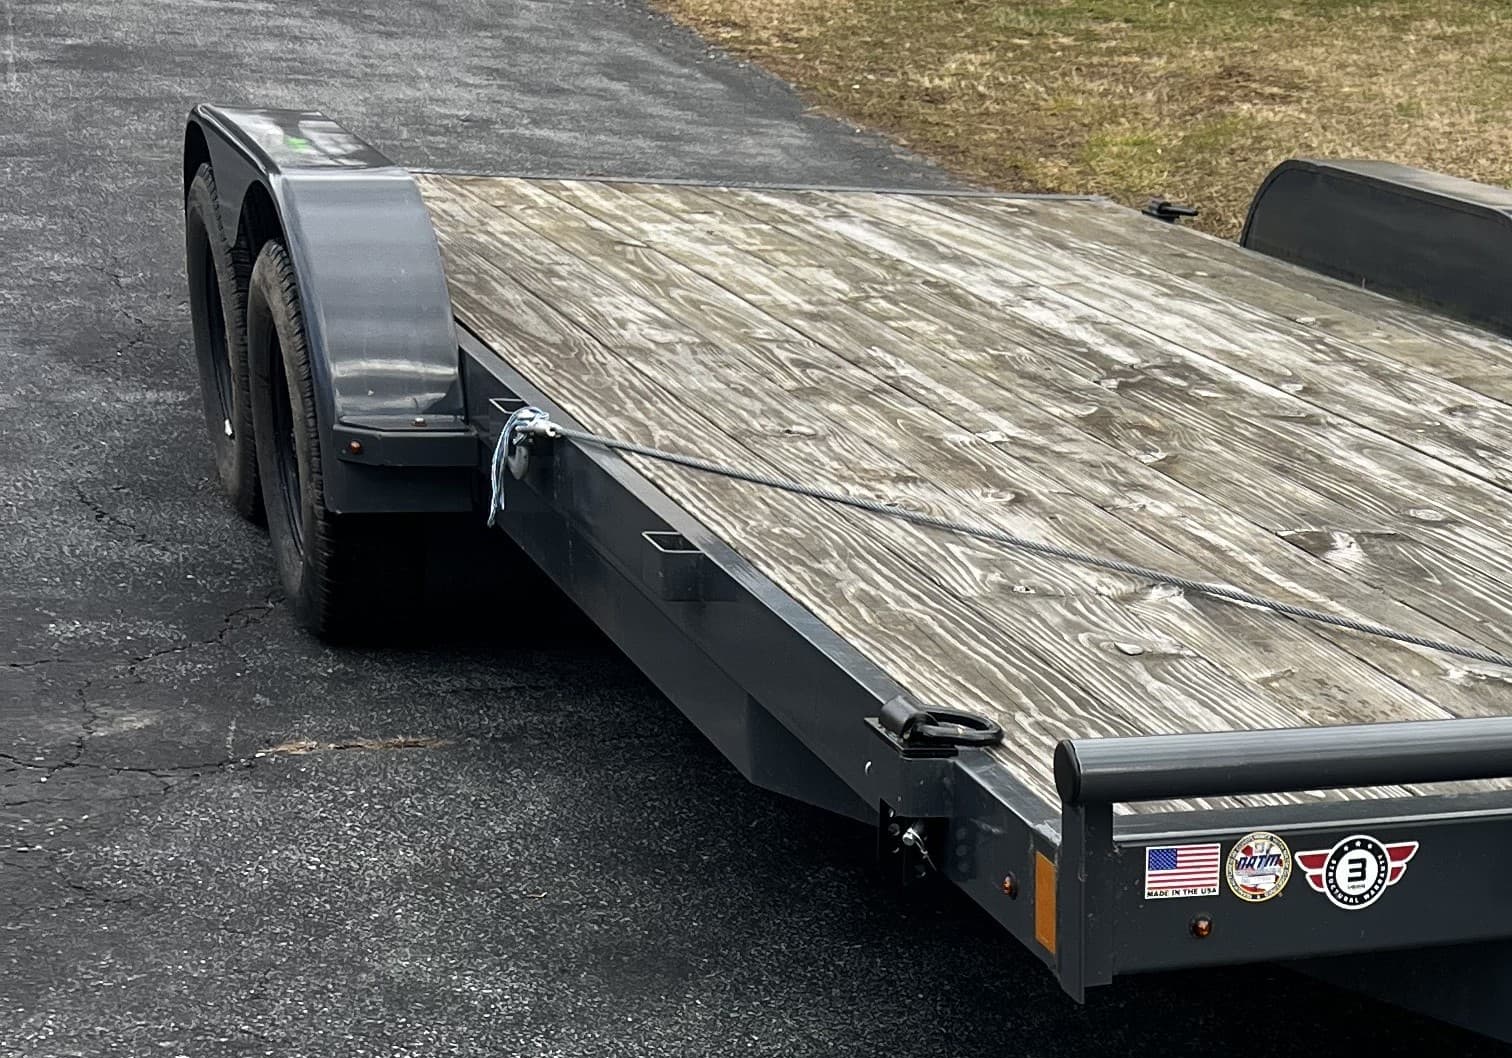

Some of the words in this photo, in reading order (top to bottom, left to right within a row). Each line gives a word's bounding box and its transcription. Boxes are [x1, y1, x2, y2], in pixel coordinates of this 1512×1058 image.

[1328, 859, 1360, 905] STRUCTURAL
[1347, 857, 1367, 883] 3
[1146, 889, 1170, 897] MADE
[1183, 888, 1198, 896] THE
[1200, 887, 1217, 895] USA
